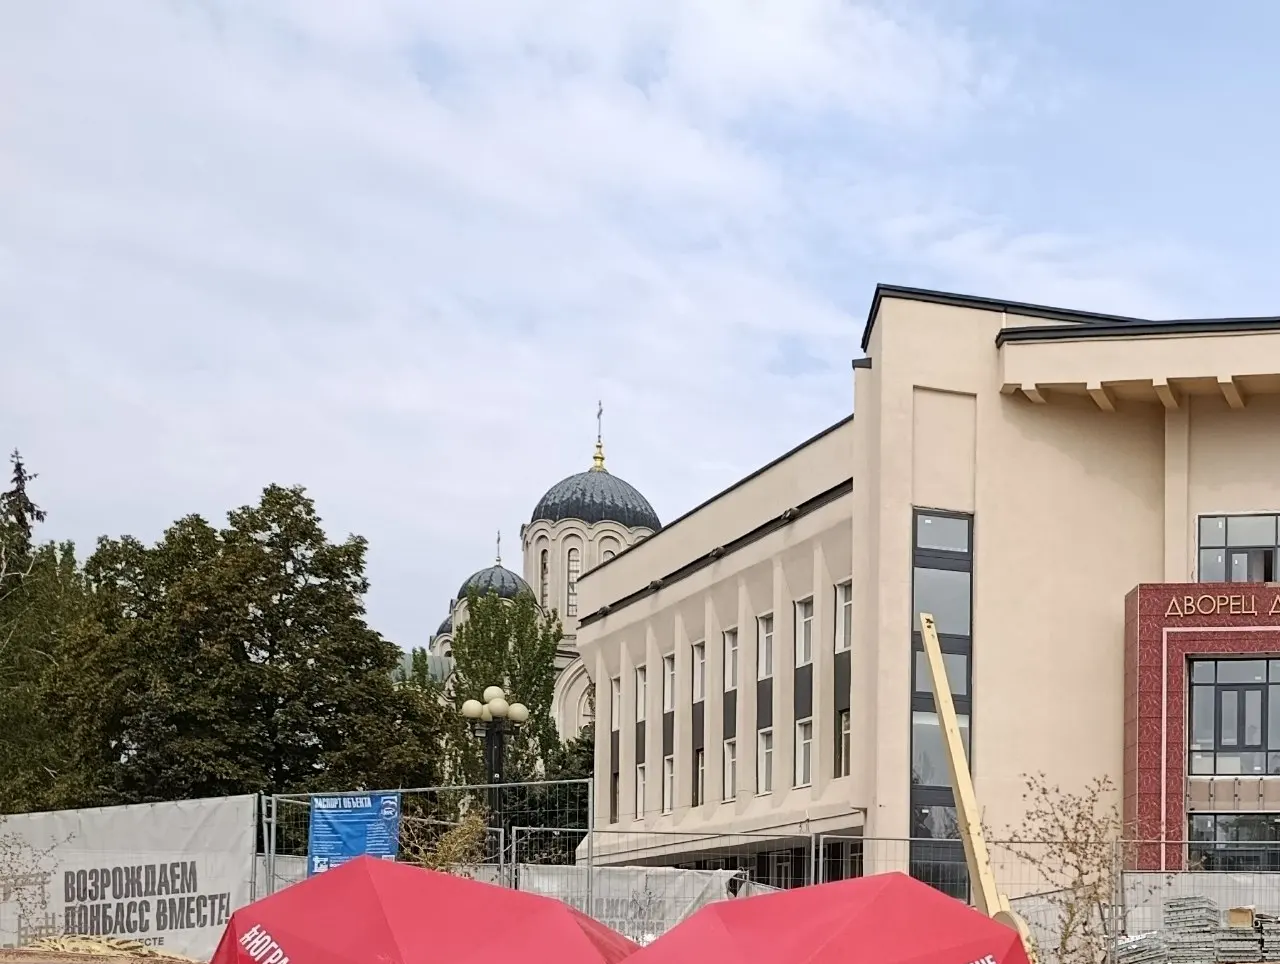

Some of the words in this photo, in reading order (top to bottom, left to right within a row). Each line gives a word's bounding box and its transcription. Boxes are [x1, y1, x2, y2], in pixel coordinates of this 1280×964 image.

[1165, 594, 1258, 618] ДВОРЕЦ
[64, 860, 198, 903] ВОЗРОЖДАЕМ
[64, 899, 151, 936] ДОНБАСС
[156, 891, 231, 932] ВМЕСТЕ!
